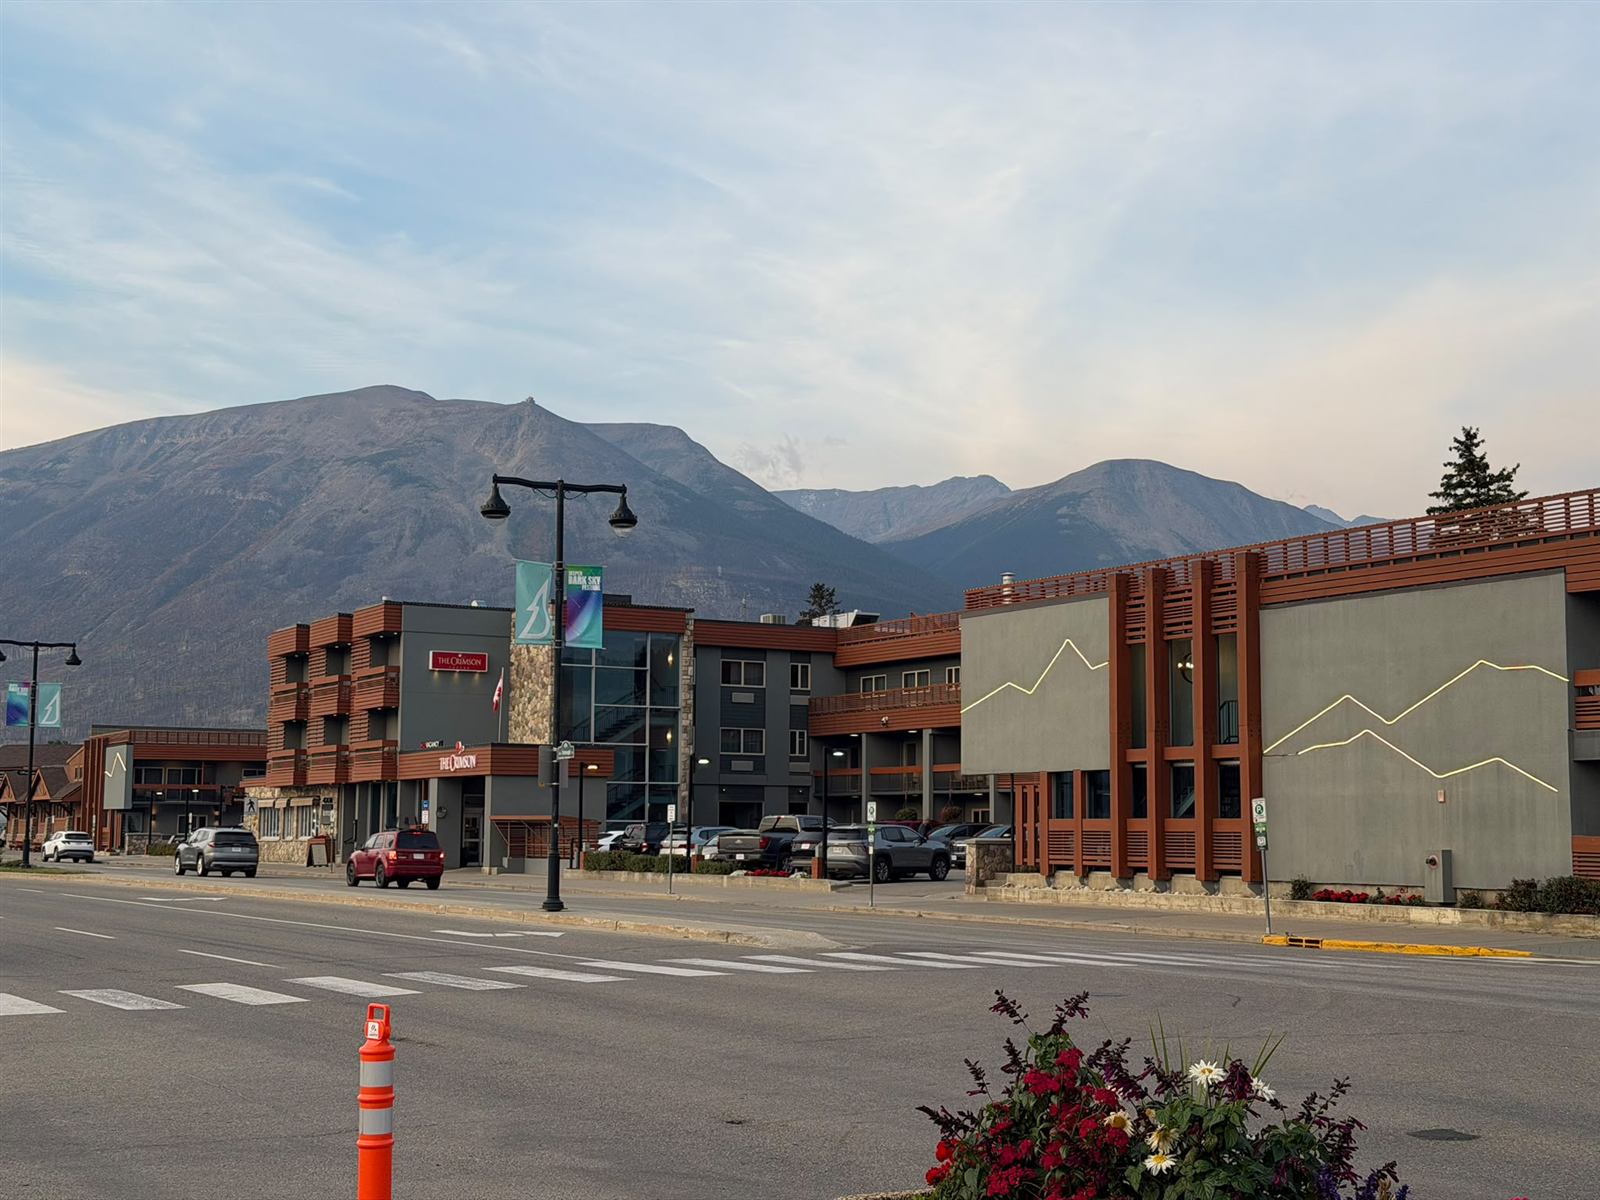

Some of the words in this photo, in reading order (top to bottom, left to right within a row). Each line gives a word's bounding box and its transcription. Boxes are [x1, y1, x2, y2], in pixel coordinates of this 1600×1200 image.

[438, 657, 450, 665] THE
[450, 656, 482, 666] CRIMSON
[439, 757, 450, 770] THE
[449, 754, 477, 772] CRIMSON
